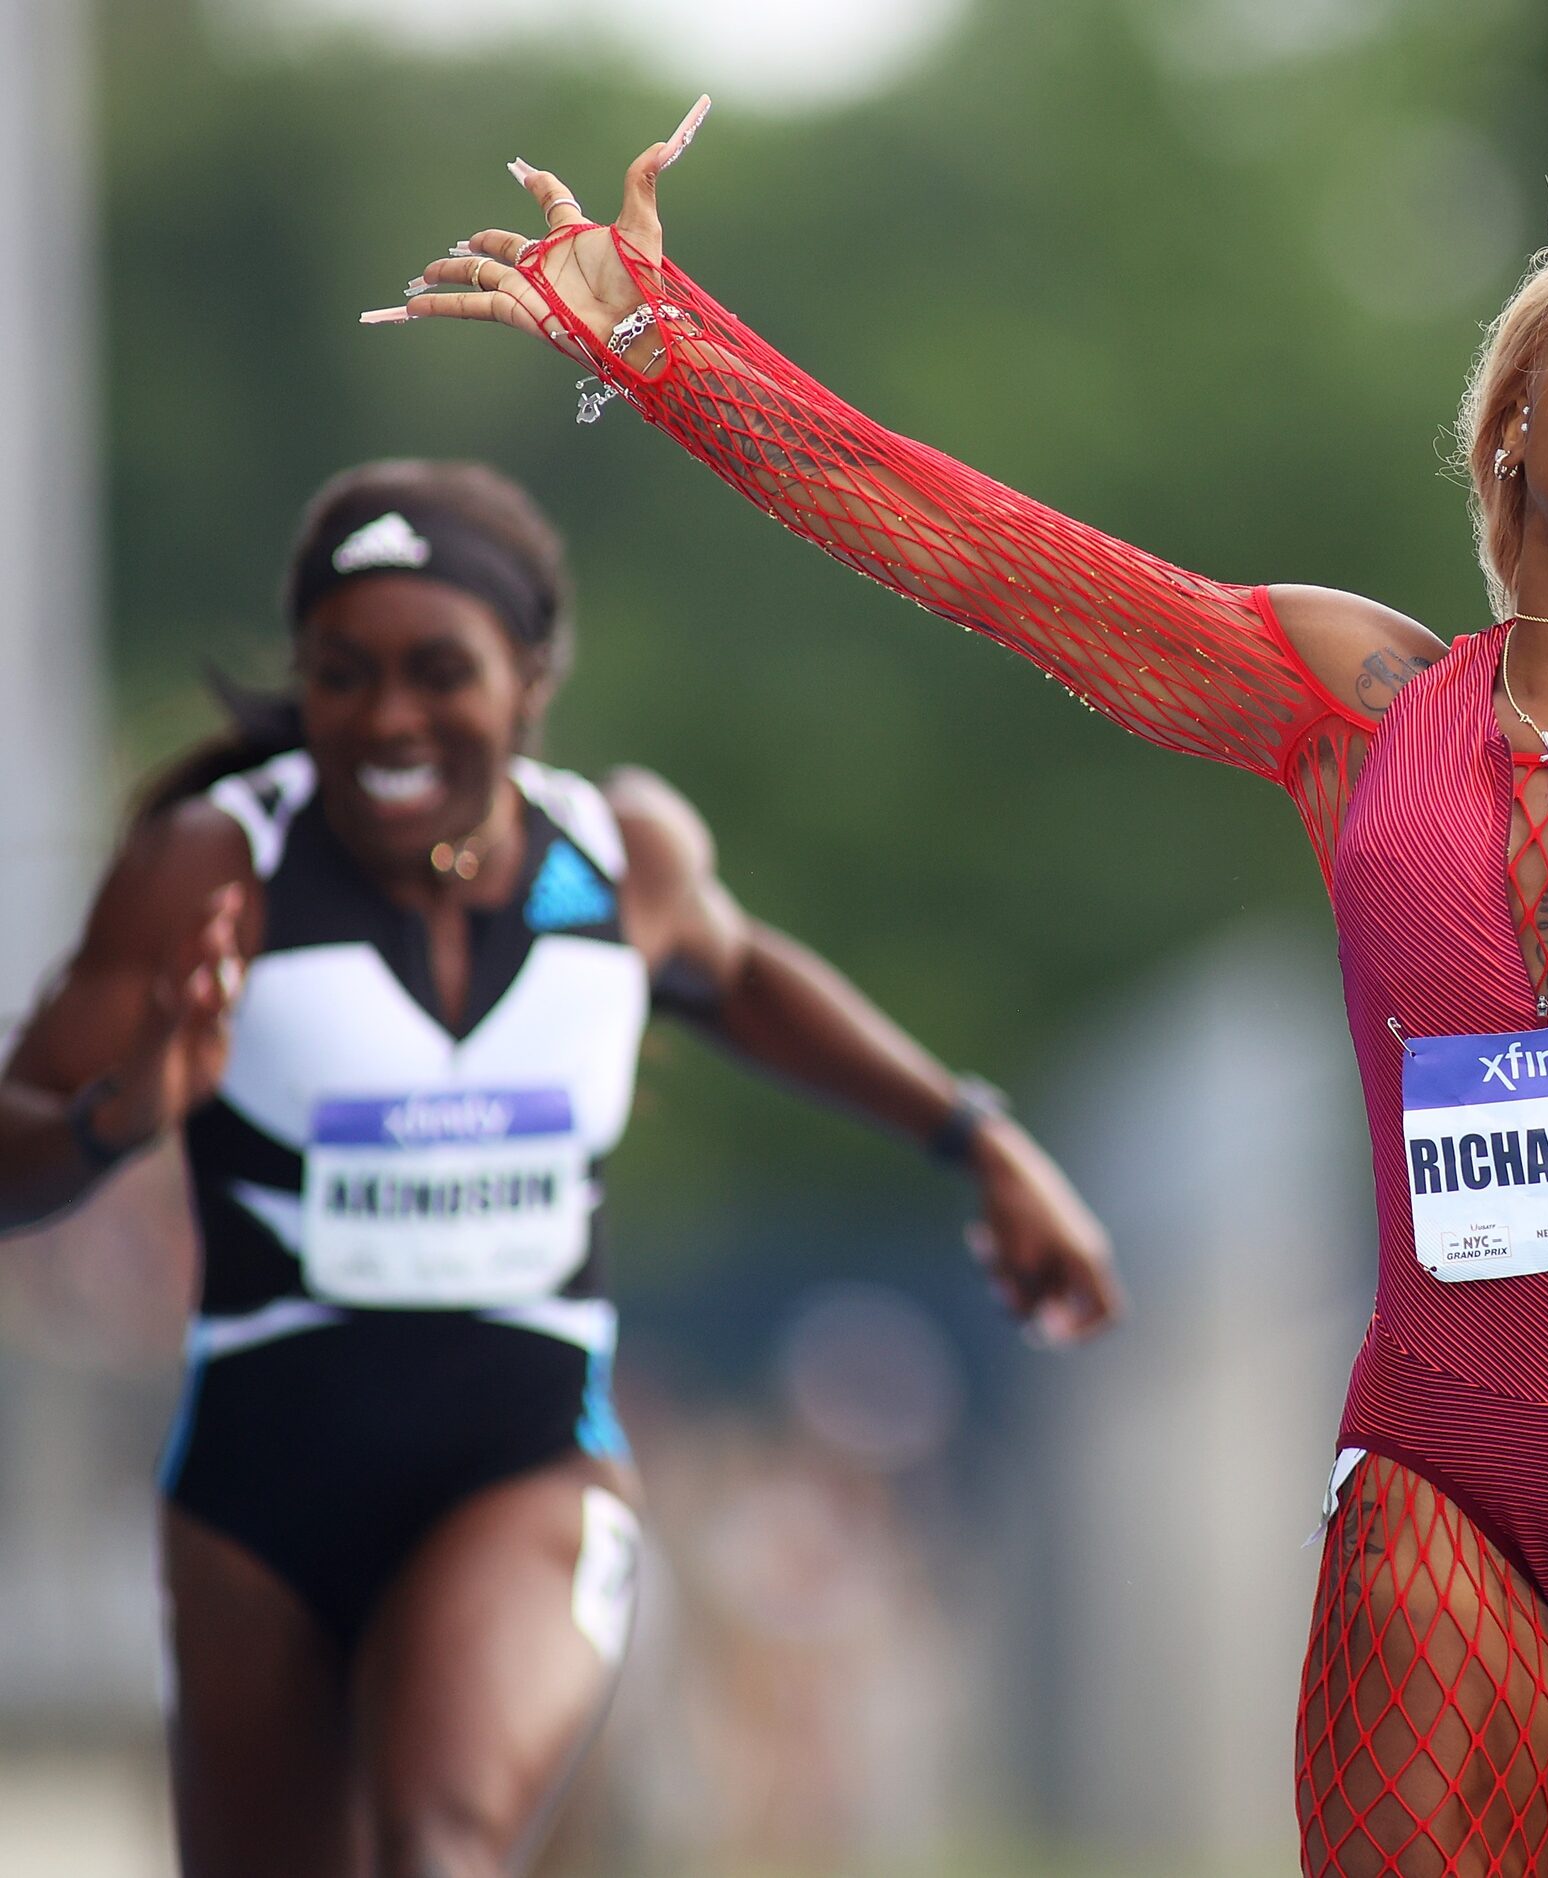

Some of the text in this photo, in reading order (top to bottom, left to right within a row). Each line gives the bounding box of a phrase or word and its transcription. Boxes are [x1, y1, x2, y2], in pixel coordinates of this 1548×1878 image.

[1463, 1235, 1489, 1249] NYC
[1446, 1247, 1508, 1260] GRAND PRIX
